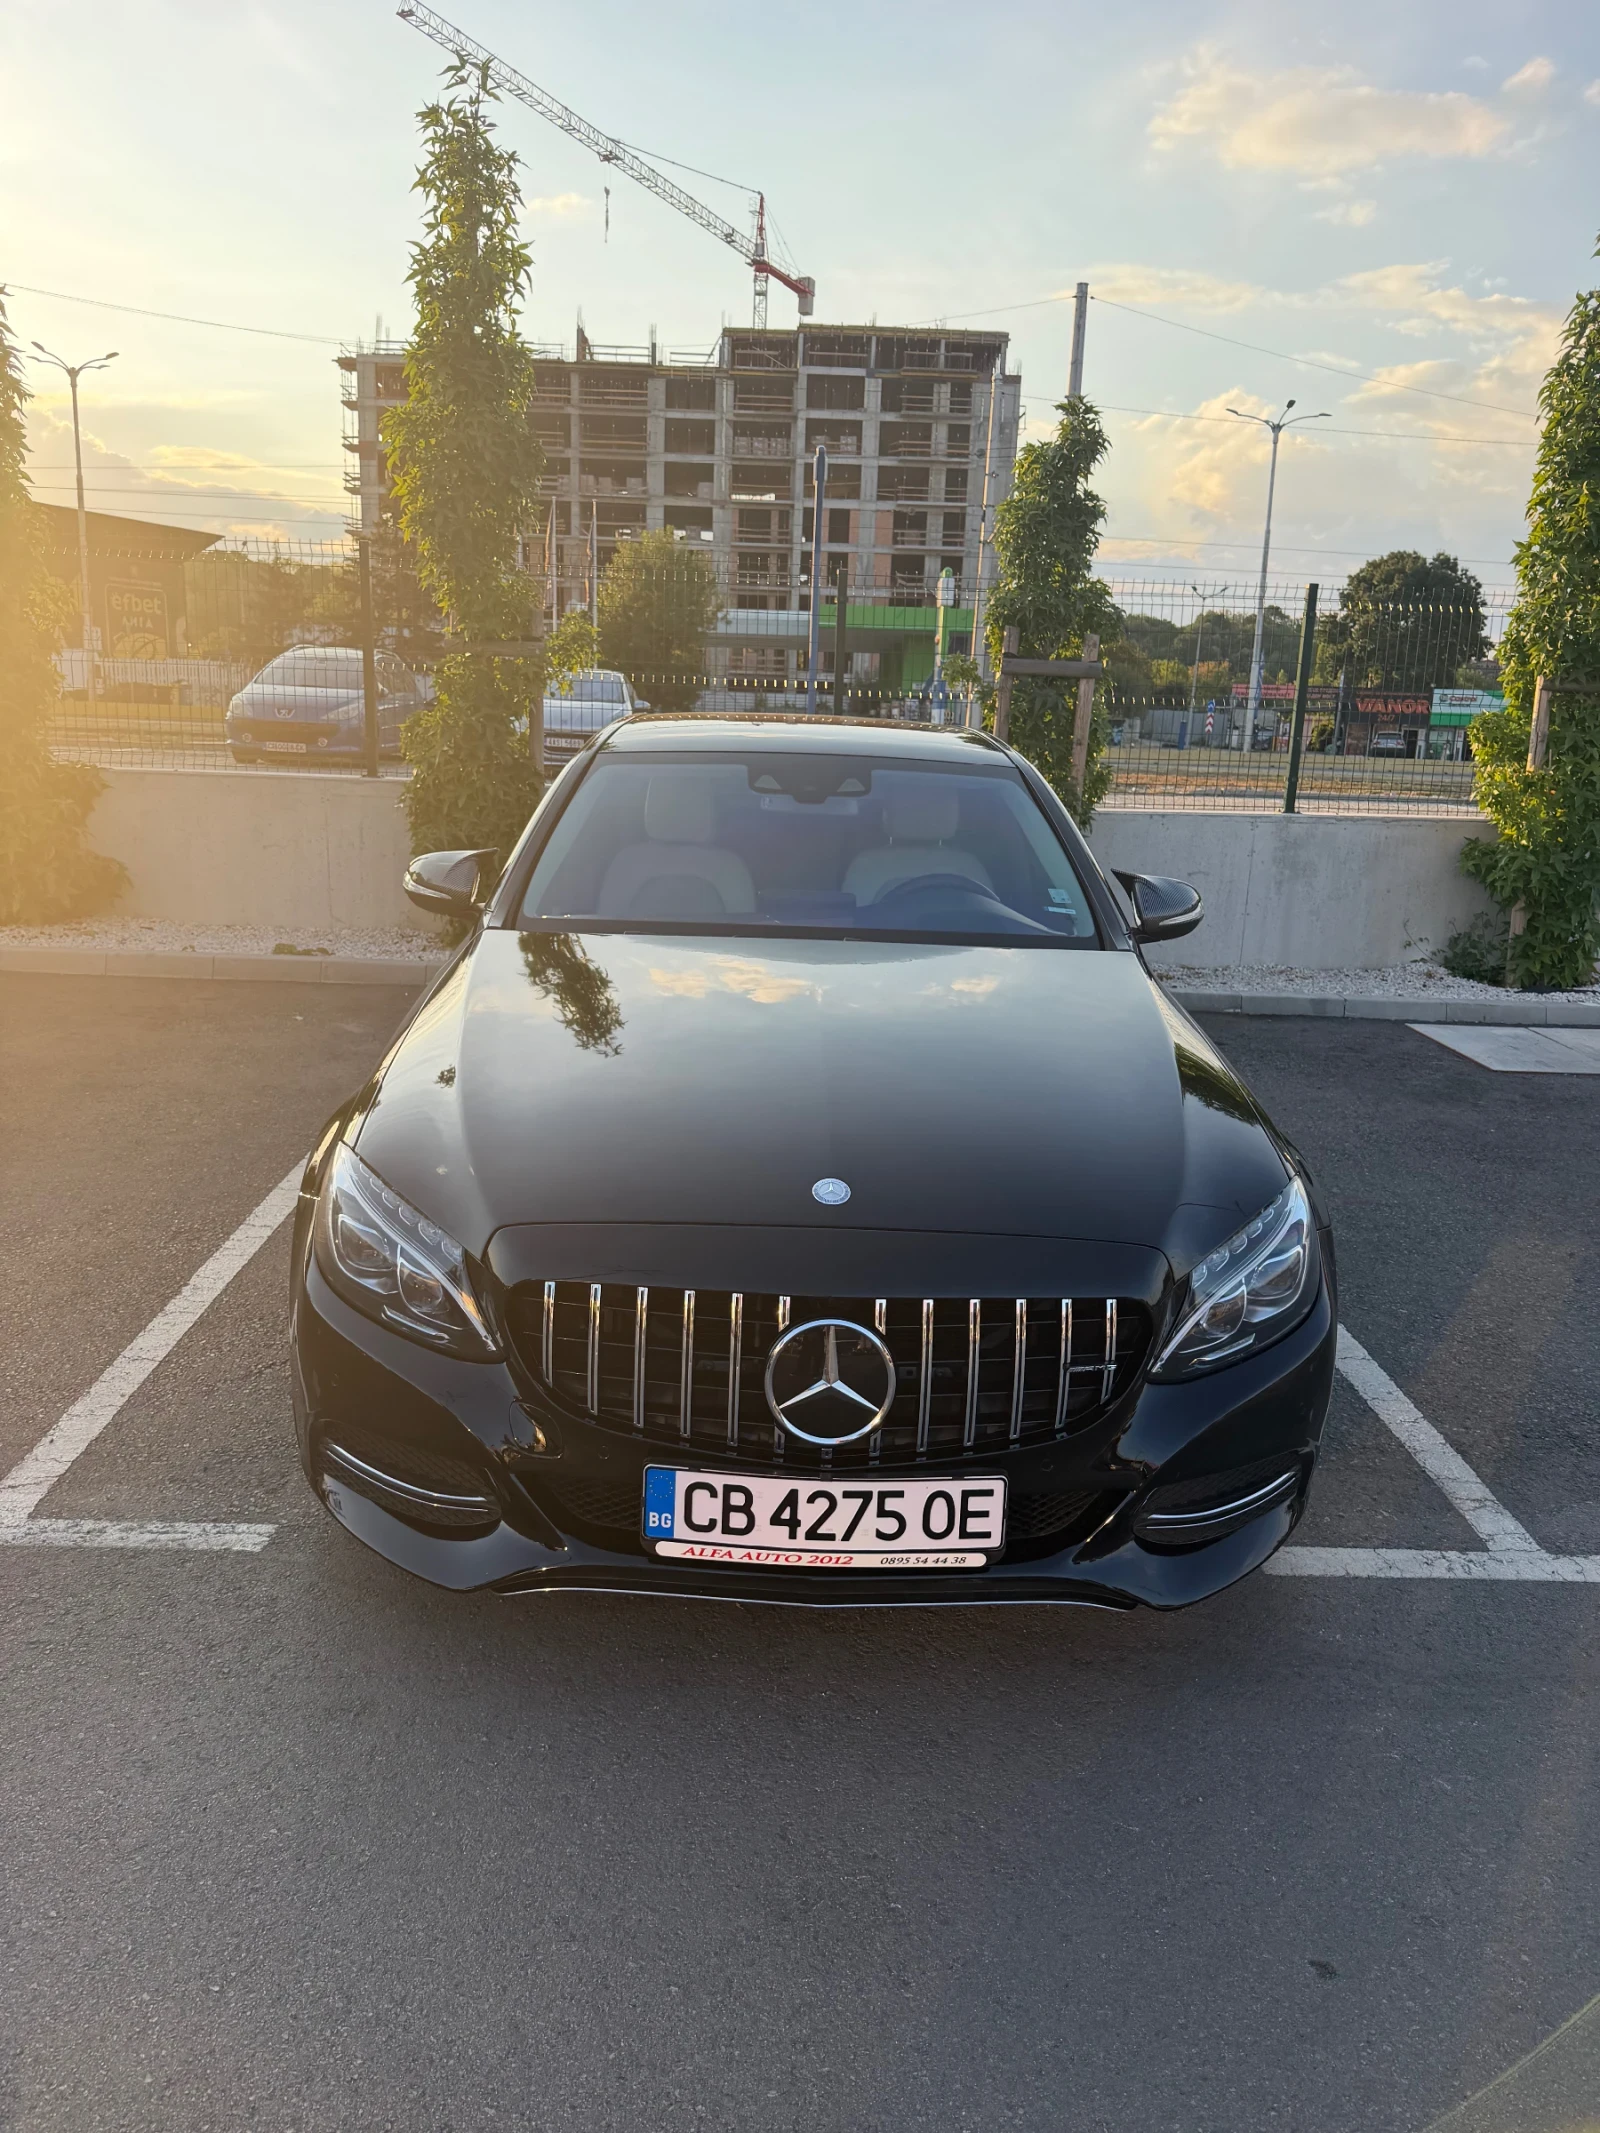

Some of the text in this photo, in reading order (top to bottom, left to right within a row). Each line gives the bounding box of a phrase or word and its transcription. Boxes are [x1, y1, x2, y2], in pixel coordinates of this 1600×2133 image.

[110, 591, 163, 615] efbet
[1355, 698, 1430, 715] VIANOR
[649, 1512, 672, 1528] BG
[684, 1481, 756, 1536] CB
[769, 1488, 907, 1541] 4275
[681, 1546, 967, 1565] ALFA AUTO 2012 0895 54 44 38
